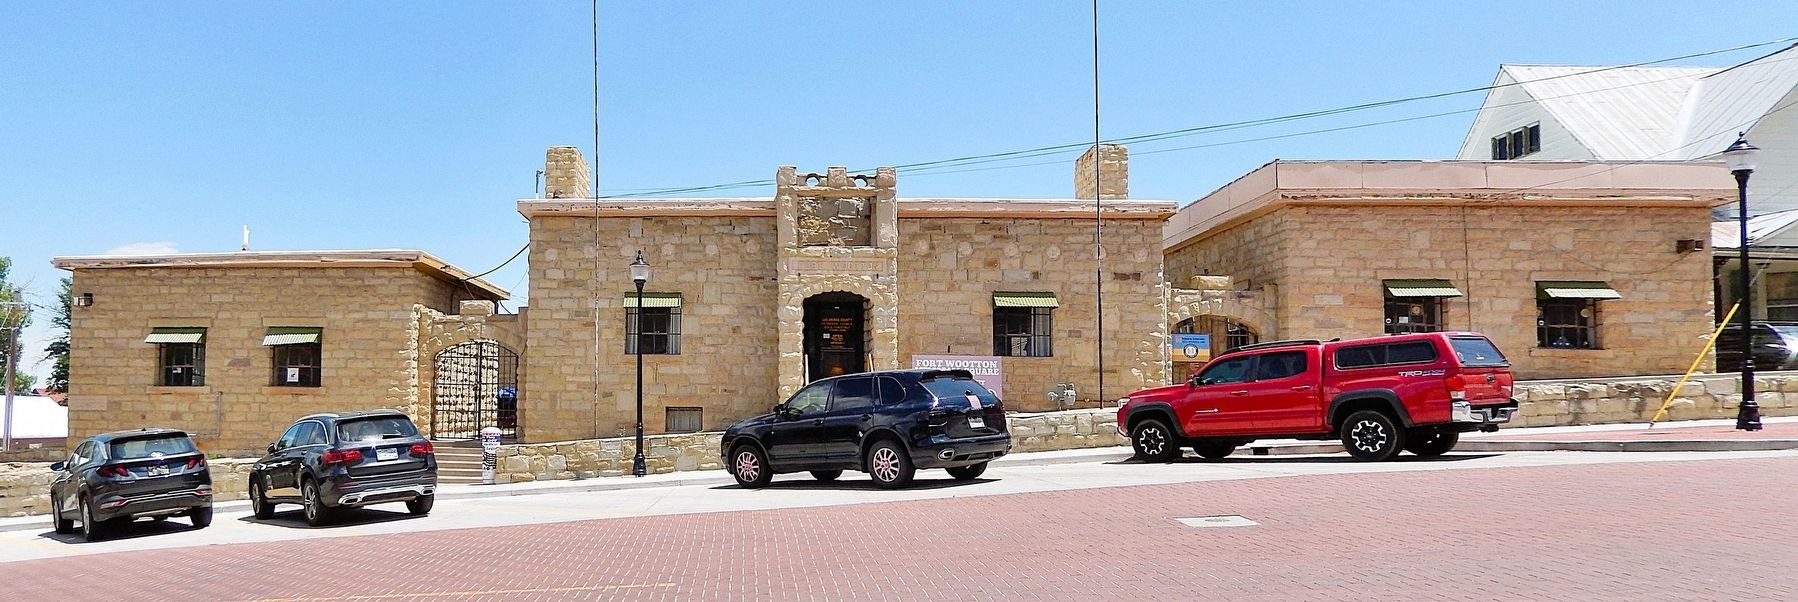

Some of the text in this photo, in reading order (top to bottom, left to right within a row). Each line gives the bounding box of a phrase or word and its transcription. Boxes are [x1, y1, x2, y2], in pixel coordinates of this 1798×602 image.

[915, 359, 943, 368] FORT
[945, 360, 998, 369] WOOTTON
[1398, 370, 1422, 378] TRD
